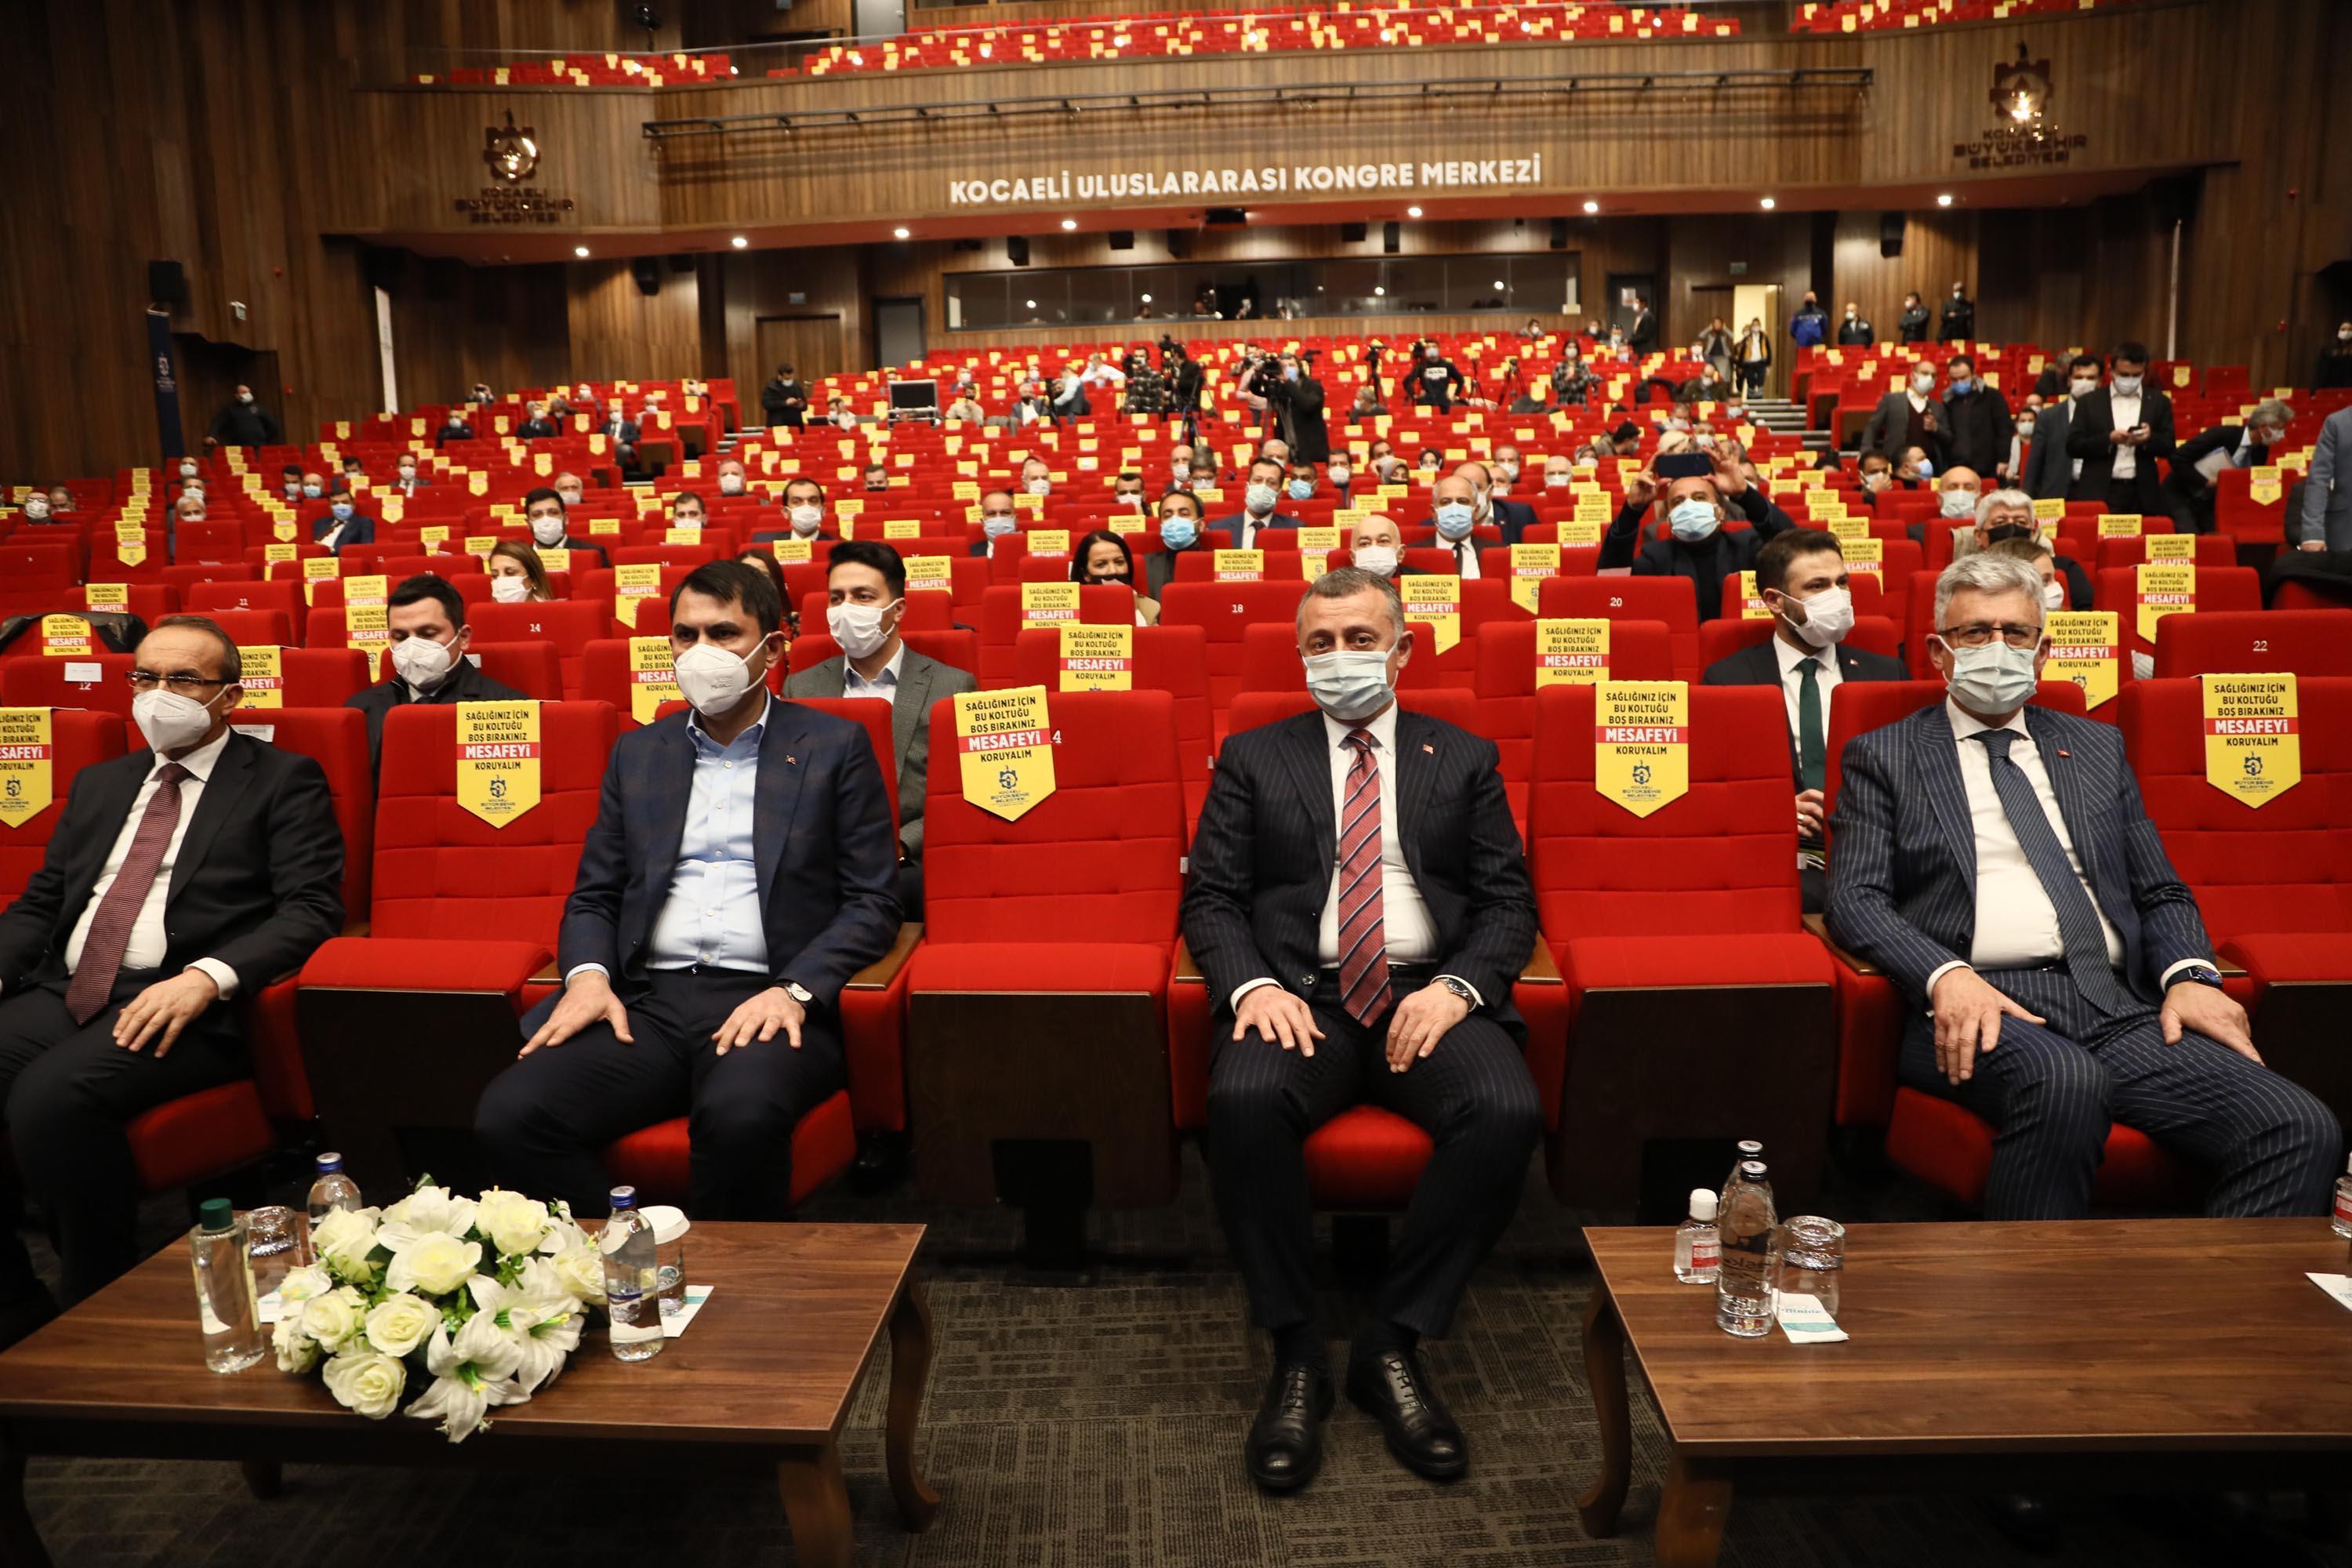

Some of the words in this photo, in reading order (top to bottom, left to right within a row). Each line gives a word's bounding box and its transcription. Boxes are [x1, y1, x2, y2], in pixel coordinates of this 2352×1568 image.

[950, 170, 1069, 203] KOCAELİ
[1076, 167, 1287, 198] ULUSLARARASI
[1294, 162, 1414, 190] KONGRE
[1421, 153, 1541, 185] MERKEZİ
[1610, 597, 1623, 607] 20
[1232, 604, 1243, 613] 18
[529, 623, 541, 633] 14
[352, 630, 389, 640] MESAFEY
[2252, 641, 2268, 652] 22
[638, 670, 676, 682] MESAF
[2214, 683, 2265, 693] SAĞLIĞINIZ
[2267, 683, 2285, 693] İÇİN
[1606, 691, 1656, 701] SAĞLIĞINIZ
[1658, 692, 1676, 702] İÇİN
[2238, 695, 2278, 704] KOLTUĞU
[966, 697, 1016, 711] SAĞLIĞINIZ
[1018, 695, 1036, 706] İÇİN
[1628, 703, 1668, 713] KOLTUĞU
[466, 710, 510, 720] SAĞLIĞINIZ
[513, 710, 529, 720] İÇİN
[989, 708, 1029, 720] KOLTUĞU
[2218, 707, 2235, 717] BOŞ
[2238, 707, 2284, 716] BIRAKINIZ
[1609, 716, 1626, 724] BOŞ
[486, 720, 522, 731] KOLTUĞU
[971, 724, 989, 735] BOŞ
[990, 720, 1036, 731] BIRAKINIZ
[469, 734, 484, 742] BOŞ
[486, 732, 527, 741] BIRAKINIZ
[1051, 730, 1062, 744] 4
[2227, 737, 2278, 746] KORUYALIM
[981, 750, 1032, 762] KORUYALIM
[475, 761, 521, 770] KORUYALIM
